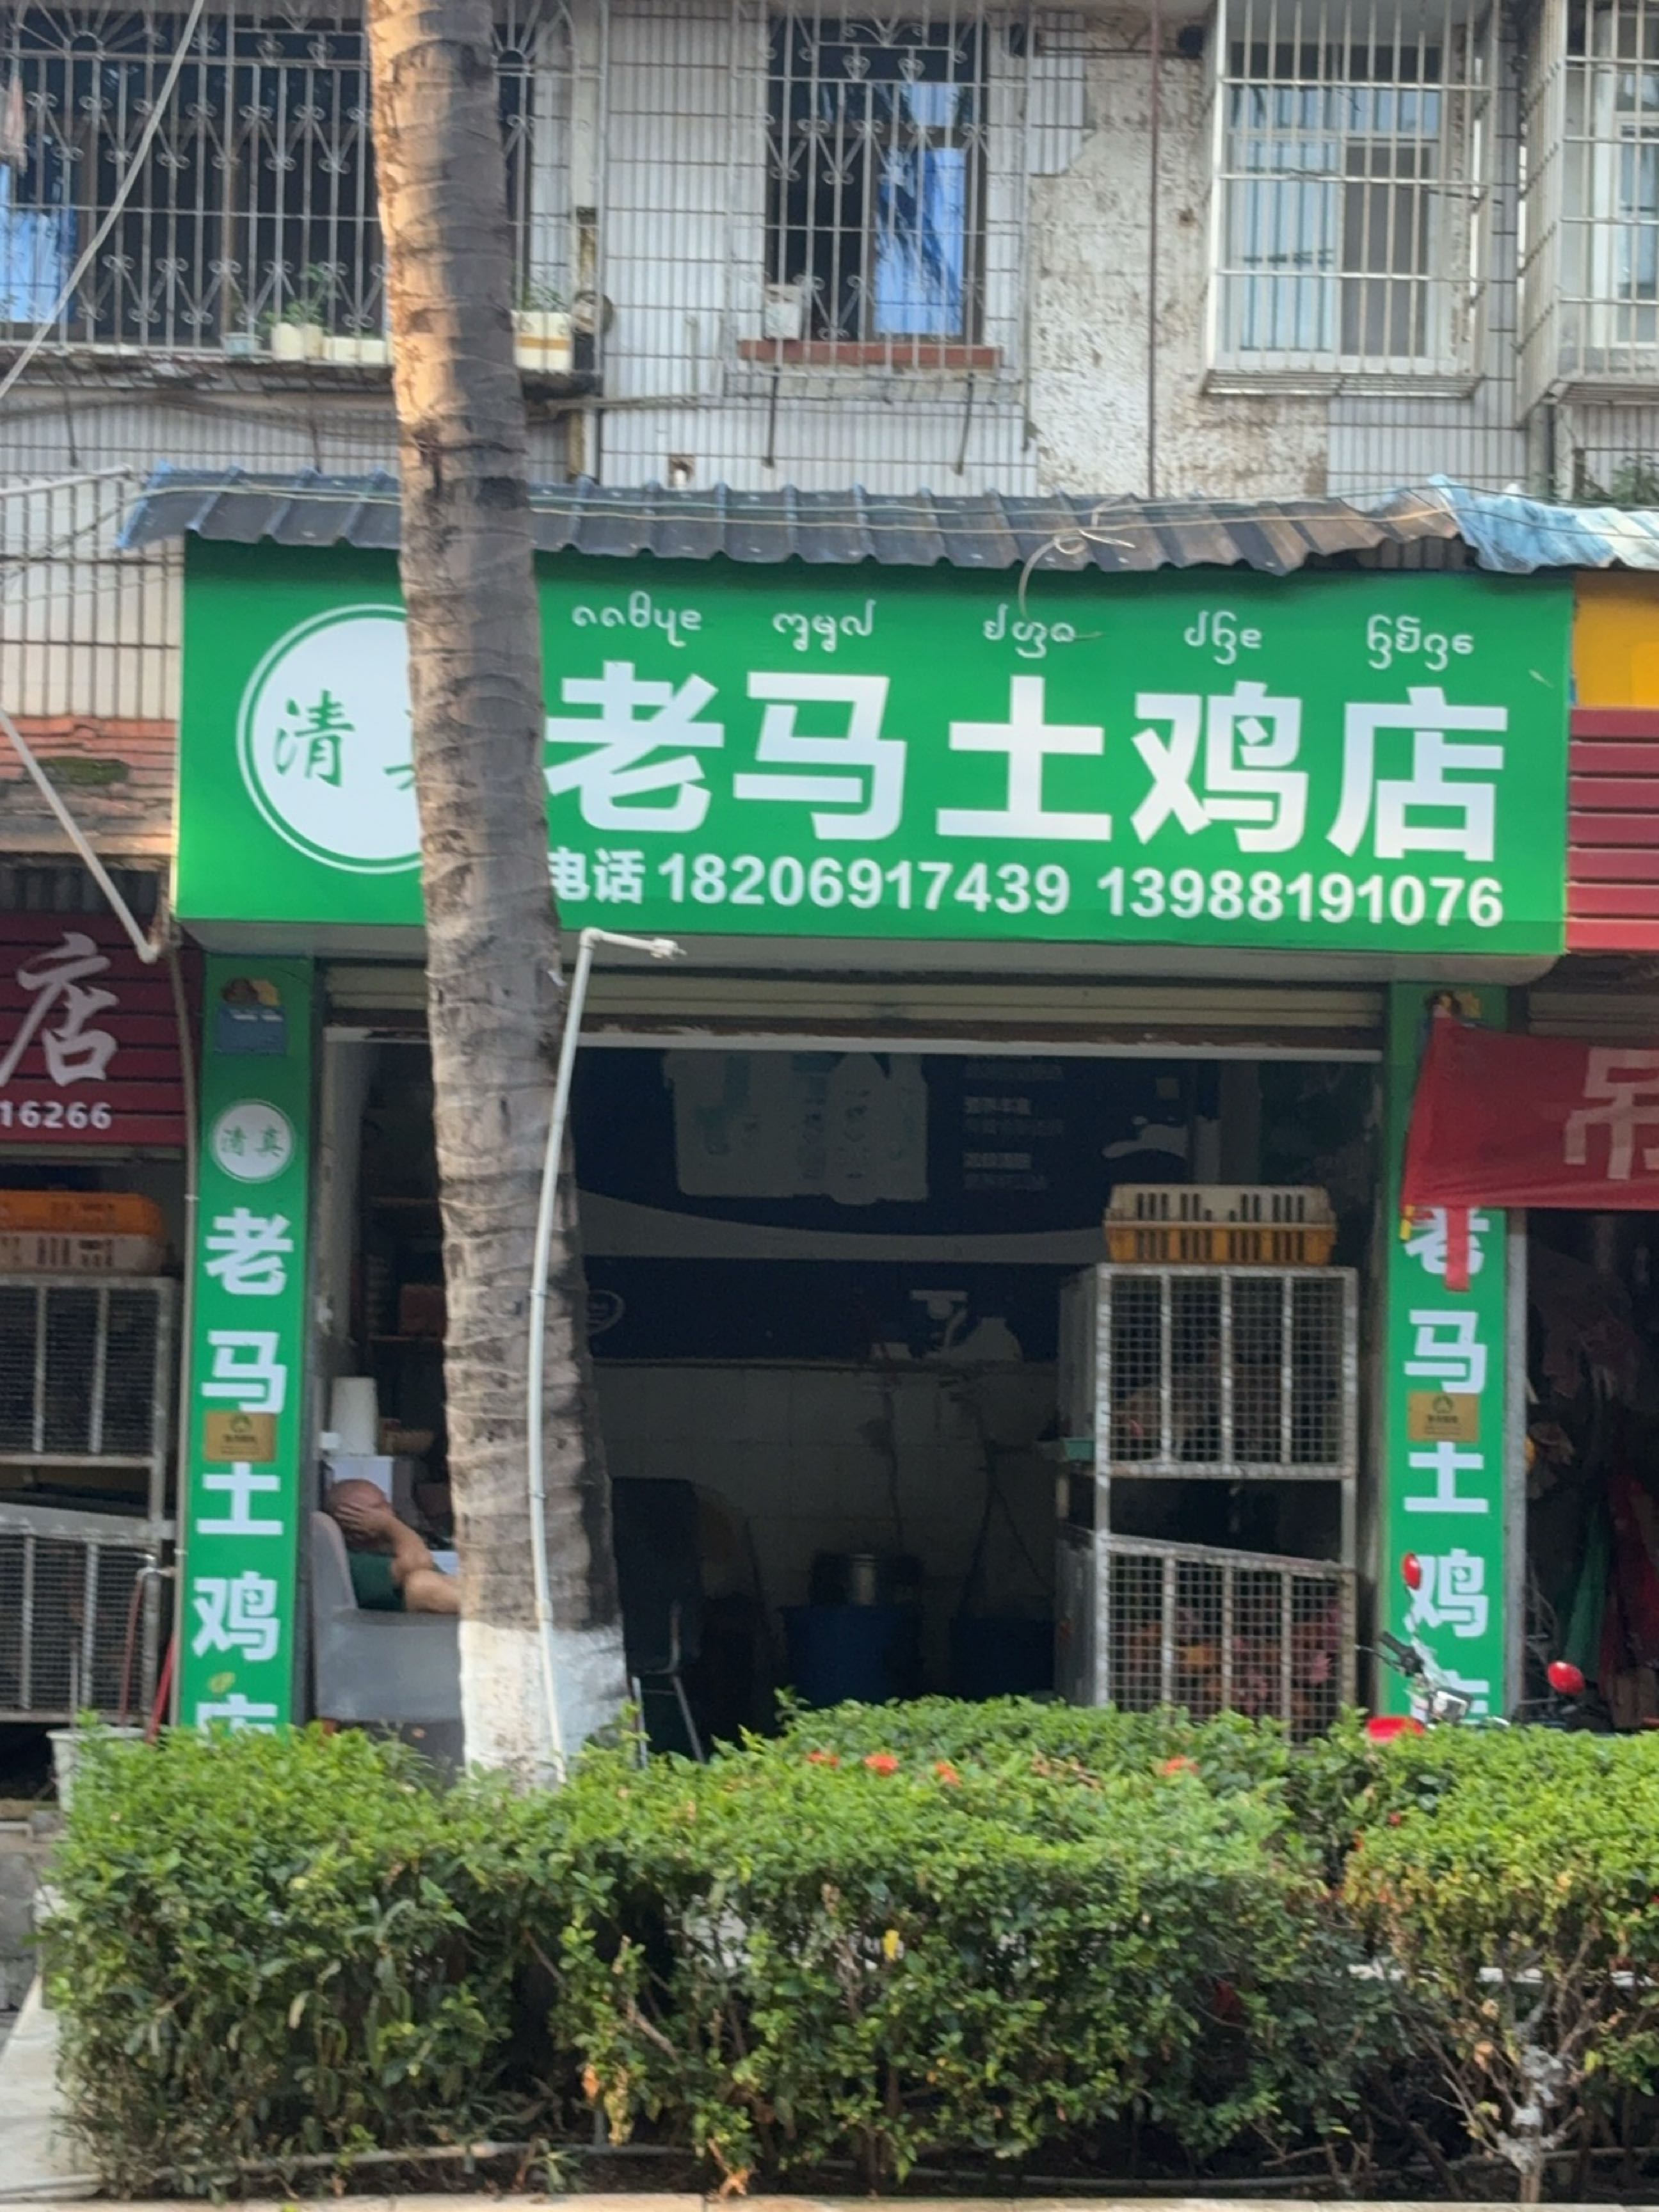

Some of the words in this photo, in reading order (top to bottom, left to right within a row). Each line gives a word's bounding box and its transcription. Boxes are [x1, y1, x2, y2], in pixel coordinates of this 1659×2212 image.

[273, 689, 416, 792] 清
[544, 661, 1509, 863] 老马土鸡店
[547, 846, 646, 904] 电话
[657, 853, 1071, 915] 18206917439
[1096, 867, 1505, 928] 13988191076
[0, 932, 120, 1087] 店
